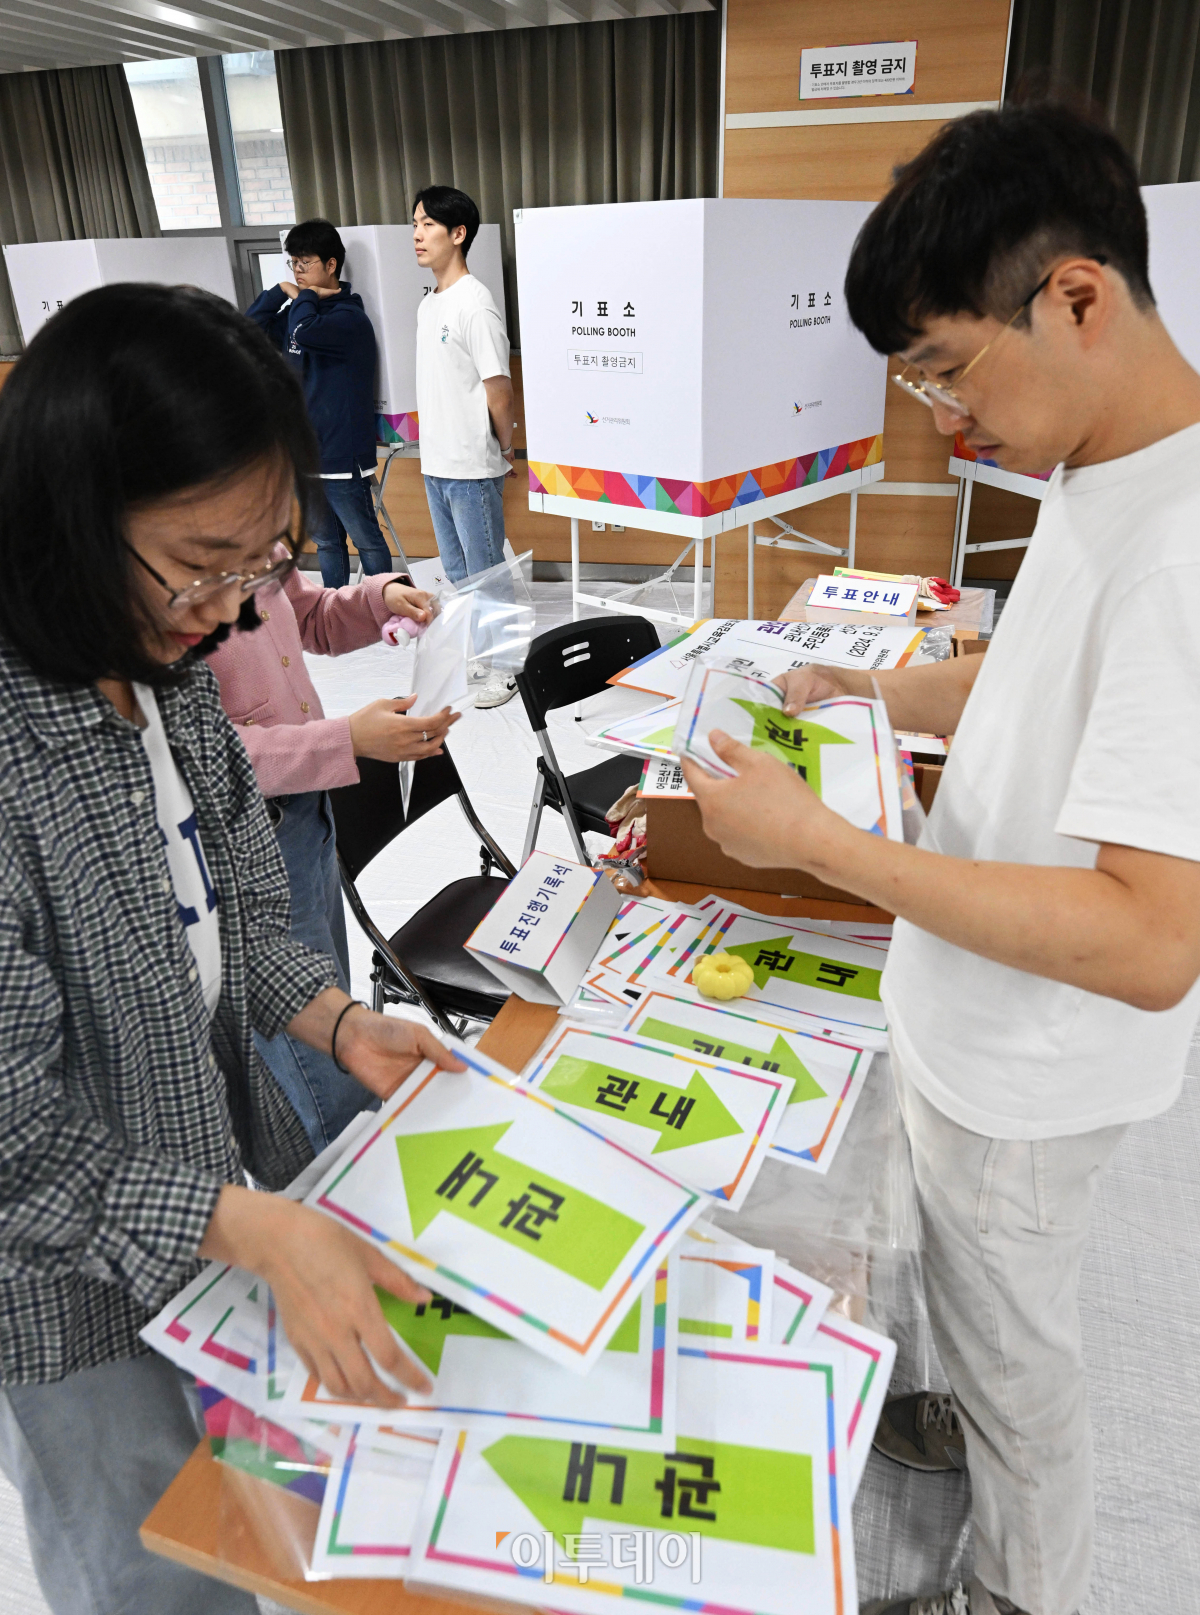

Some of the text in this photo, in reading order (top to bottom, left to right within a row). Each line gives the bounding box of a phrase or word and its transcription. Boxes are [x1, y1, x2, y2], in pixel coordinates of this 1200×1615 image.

[810, 56, 906, 79] 투표지 촬영 금지
[789, 315, 831, 329] POLLING BOOTH
[571, 326, 636, 338] POLLING BOOTH
[573, 354, 599, 367] 투표지
[681, 619, 741, 662] 서울특별시교육감보
[499, 864, 573, 954] 투표진행기록석
